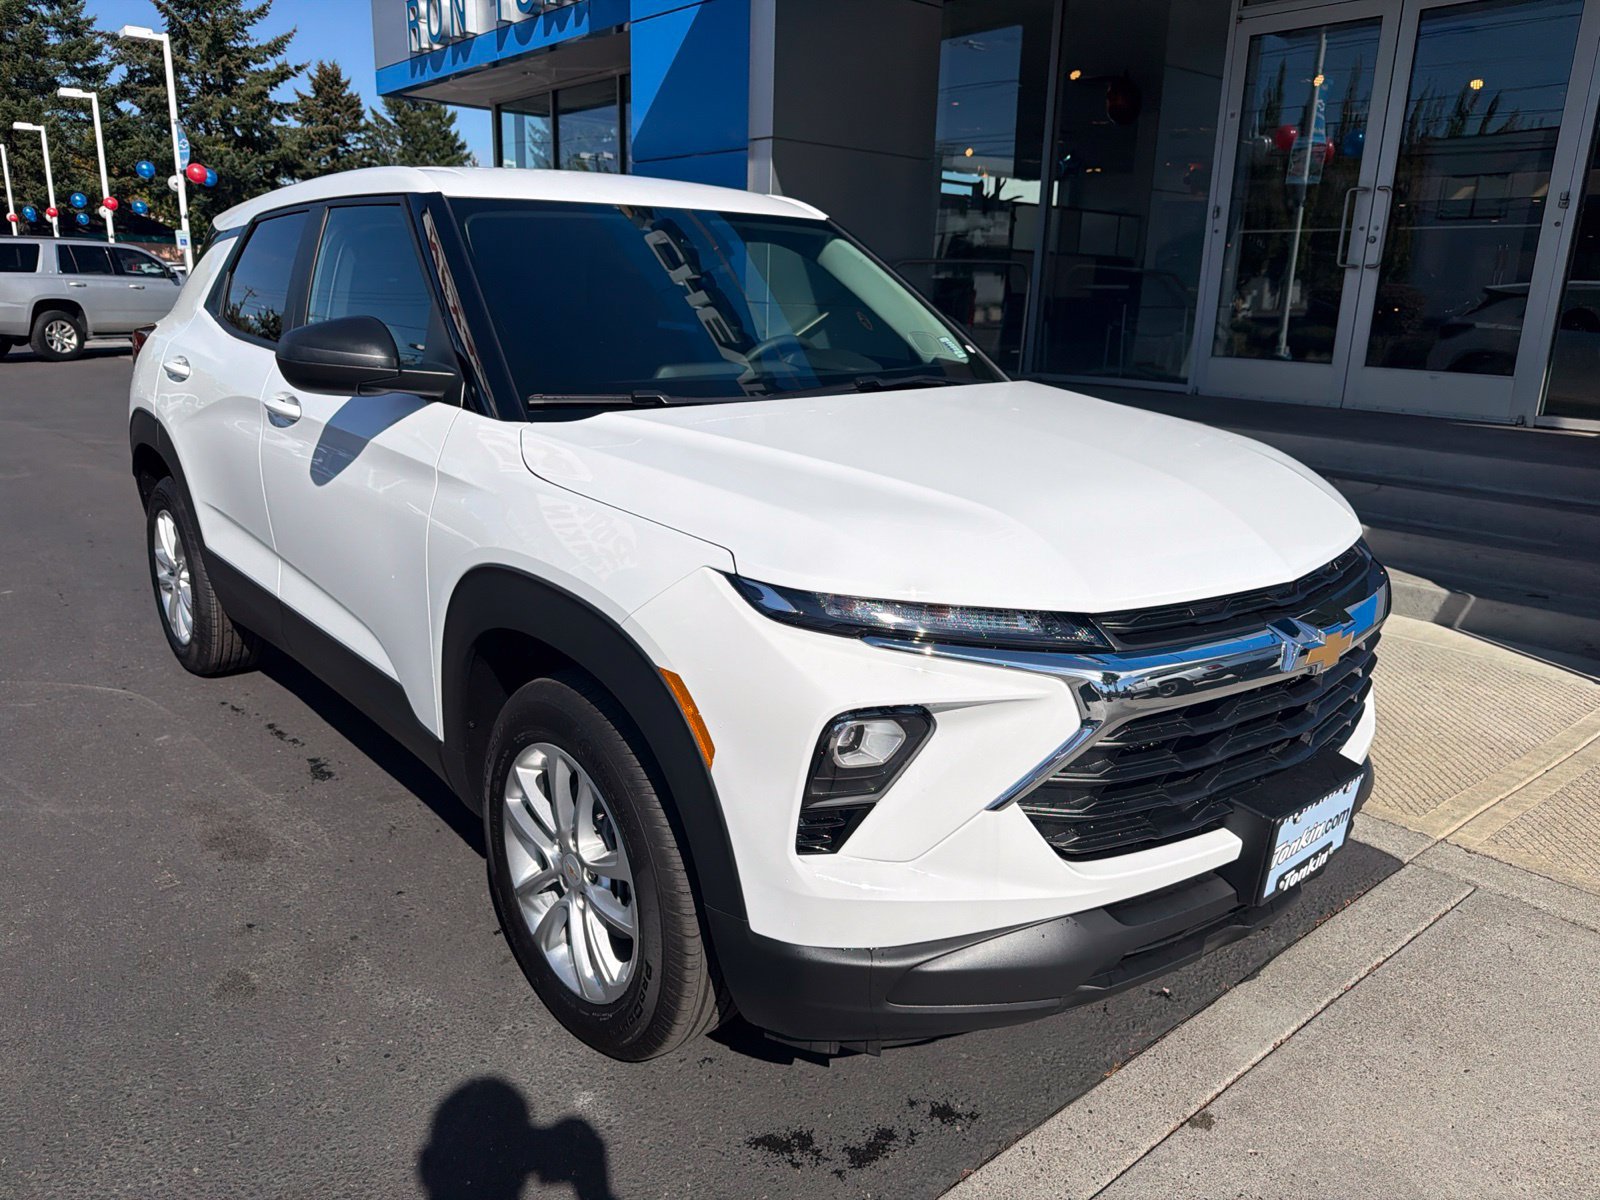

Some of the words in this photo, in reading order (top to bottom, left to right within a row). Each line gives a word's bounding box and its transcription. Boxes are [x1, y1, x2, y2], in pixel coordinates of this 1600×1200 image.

[406, 0, 467, 53] RON
[1271, 807, 1350, 870] Tonkin.com
[1282, 851, 1329, 891] Tonkin
